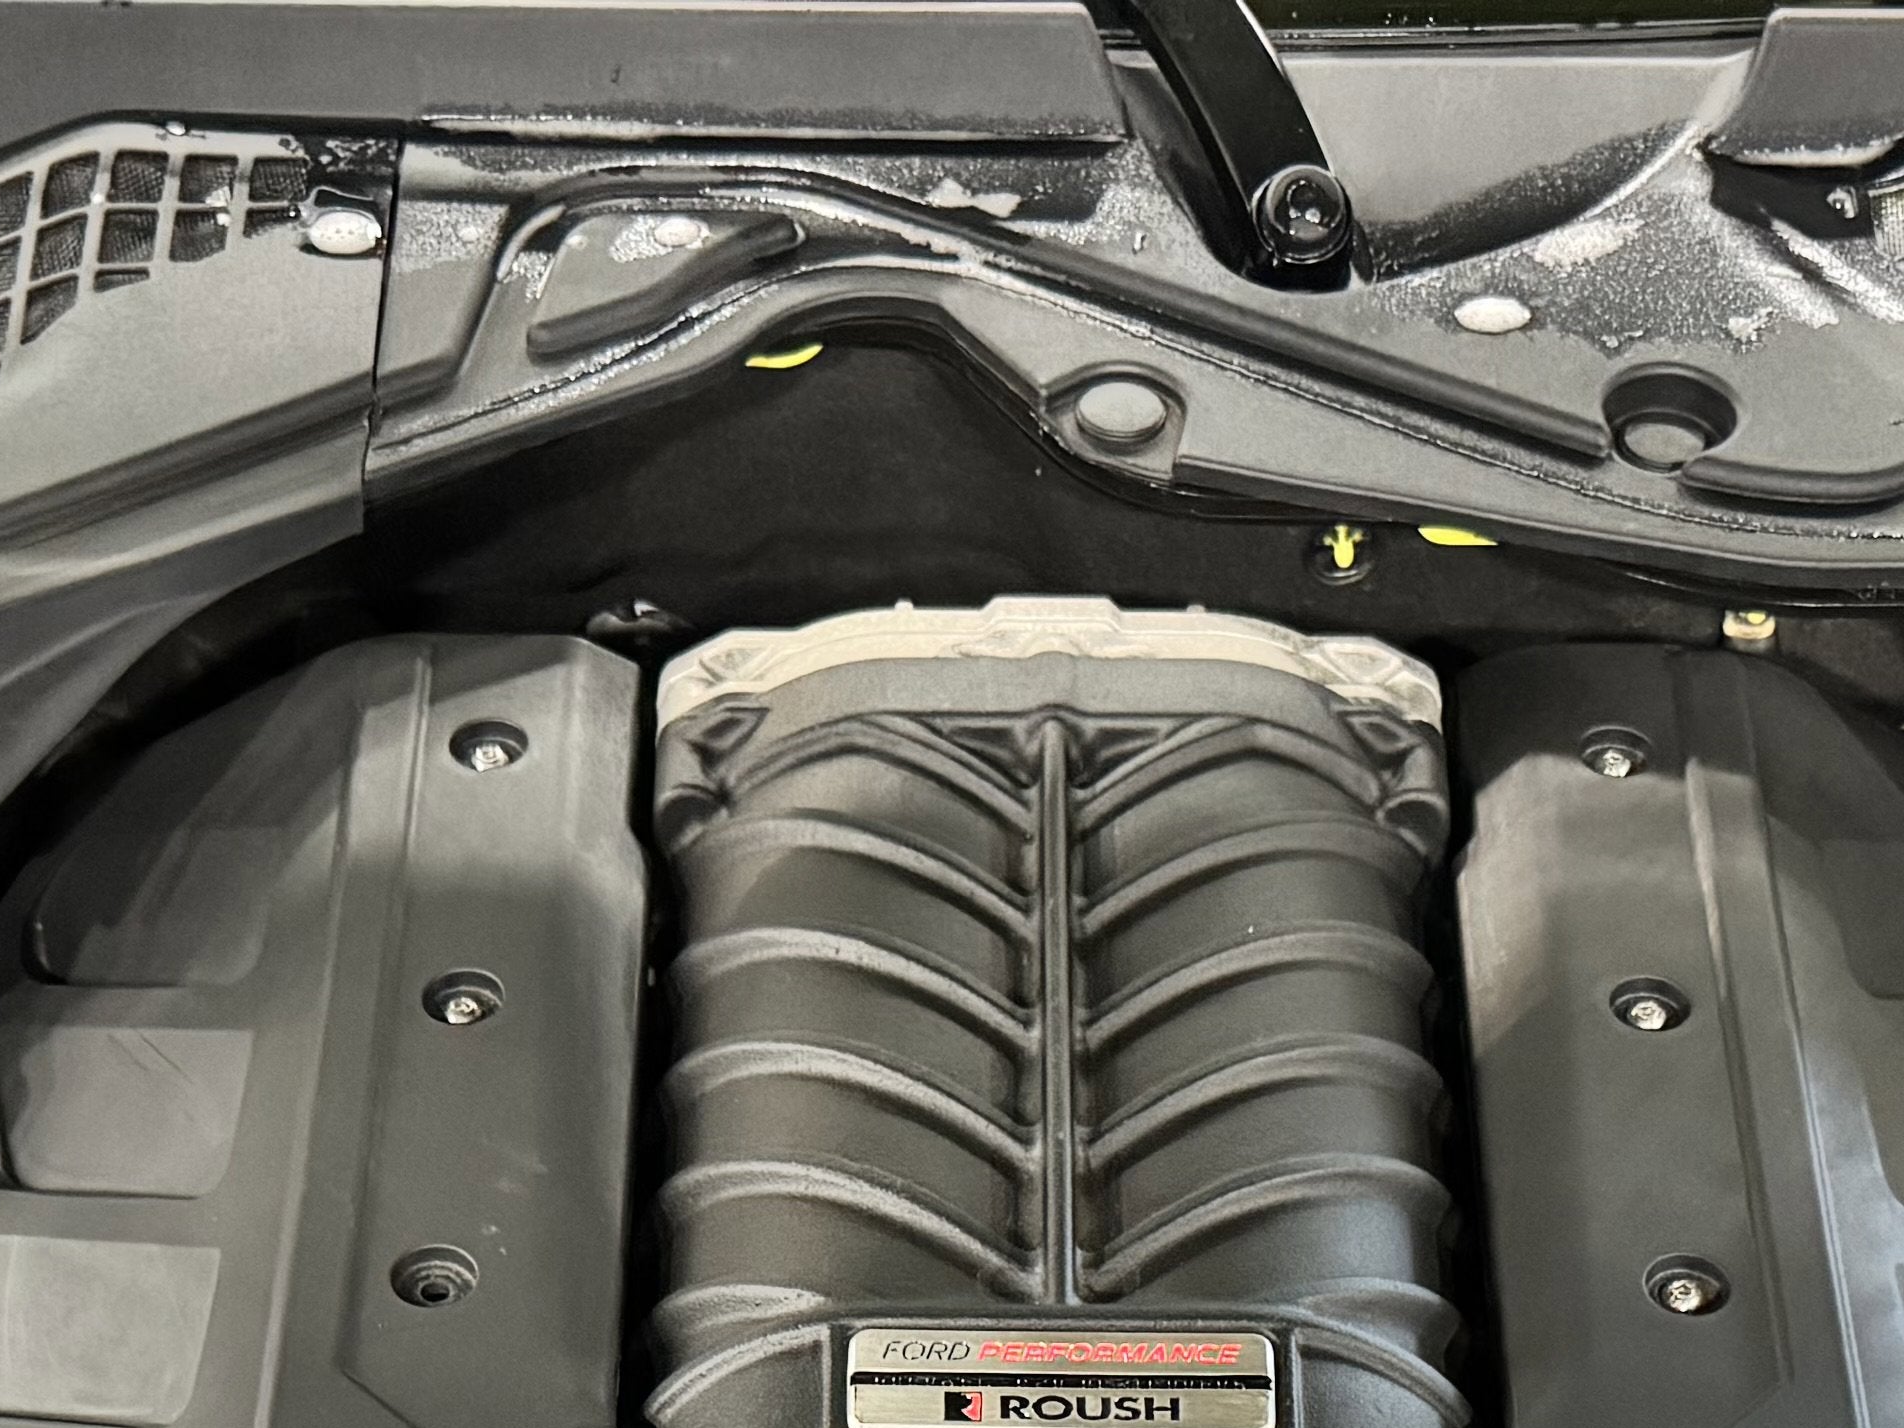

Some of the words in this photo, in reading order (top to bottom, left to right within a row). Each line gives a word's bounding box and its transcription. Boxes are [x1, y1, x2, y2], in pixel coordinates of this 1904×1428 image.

[882, 1340, 971, 1361] FORD
[976, 1340, 1245, 1366] PERFORMANCE
[1000, 1395, 1181, 1422] ROUSH
